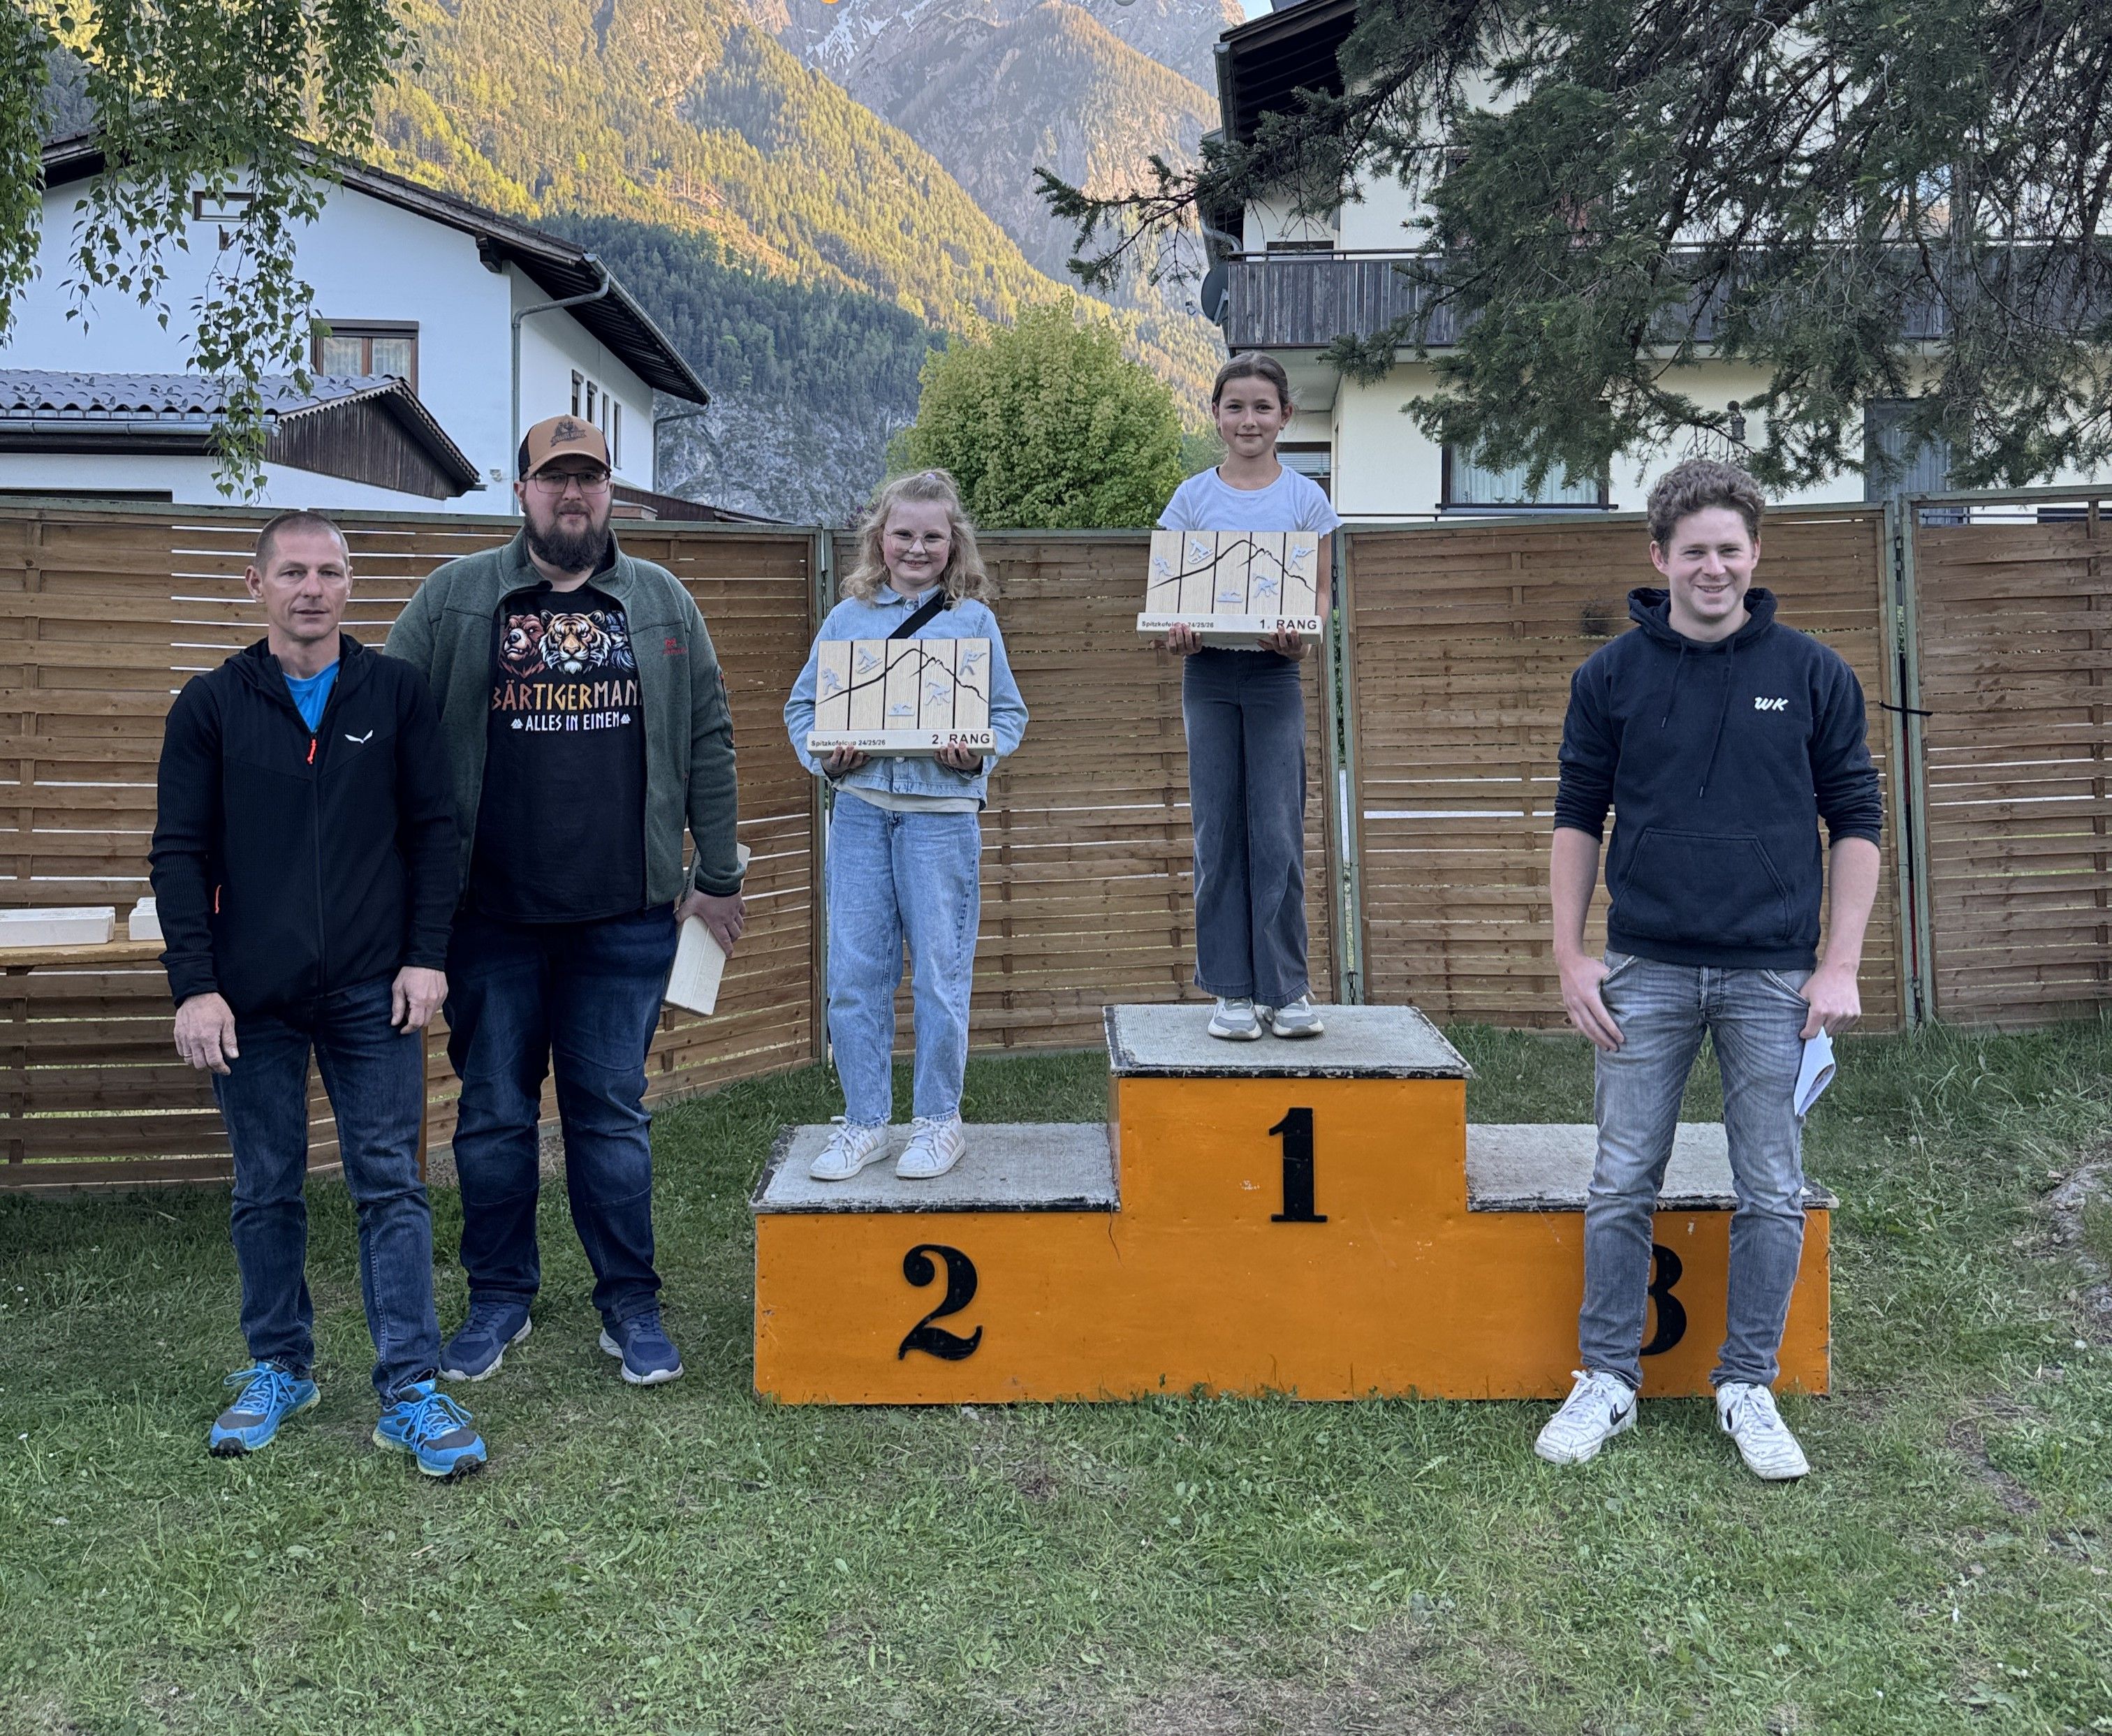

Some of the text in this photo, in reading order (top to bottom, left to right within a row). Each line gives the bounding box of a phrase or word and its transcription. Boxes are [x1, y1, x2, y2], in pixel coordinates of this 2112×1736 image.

[1260, 619, 1317, 630] 1. RANG
[492, 679, 642, 711] BÄRTIGERMAN
[1754, 696, 1789, 712] WK
[525, 711, 619, 731] ALLES IN EINEM
[932, 733, 990, 744] 2. RANG
[1269, 1108, 1327, 1223] 1
[898, 1244, 983, 1362] 2
